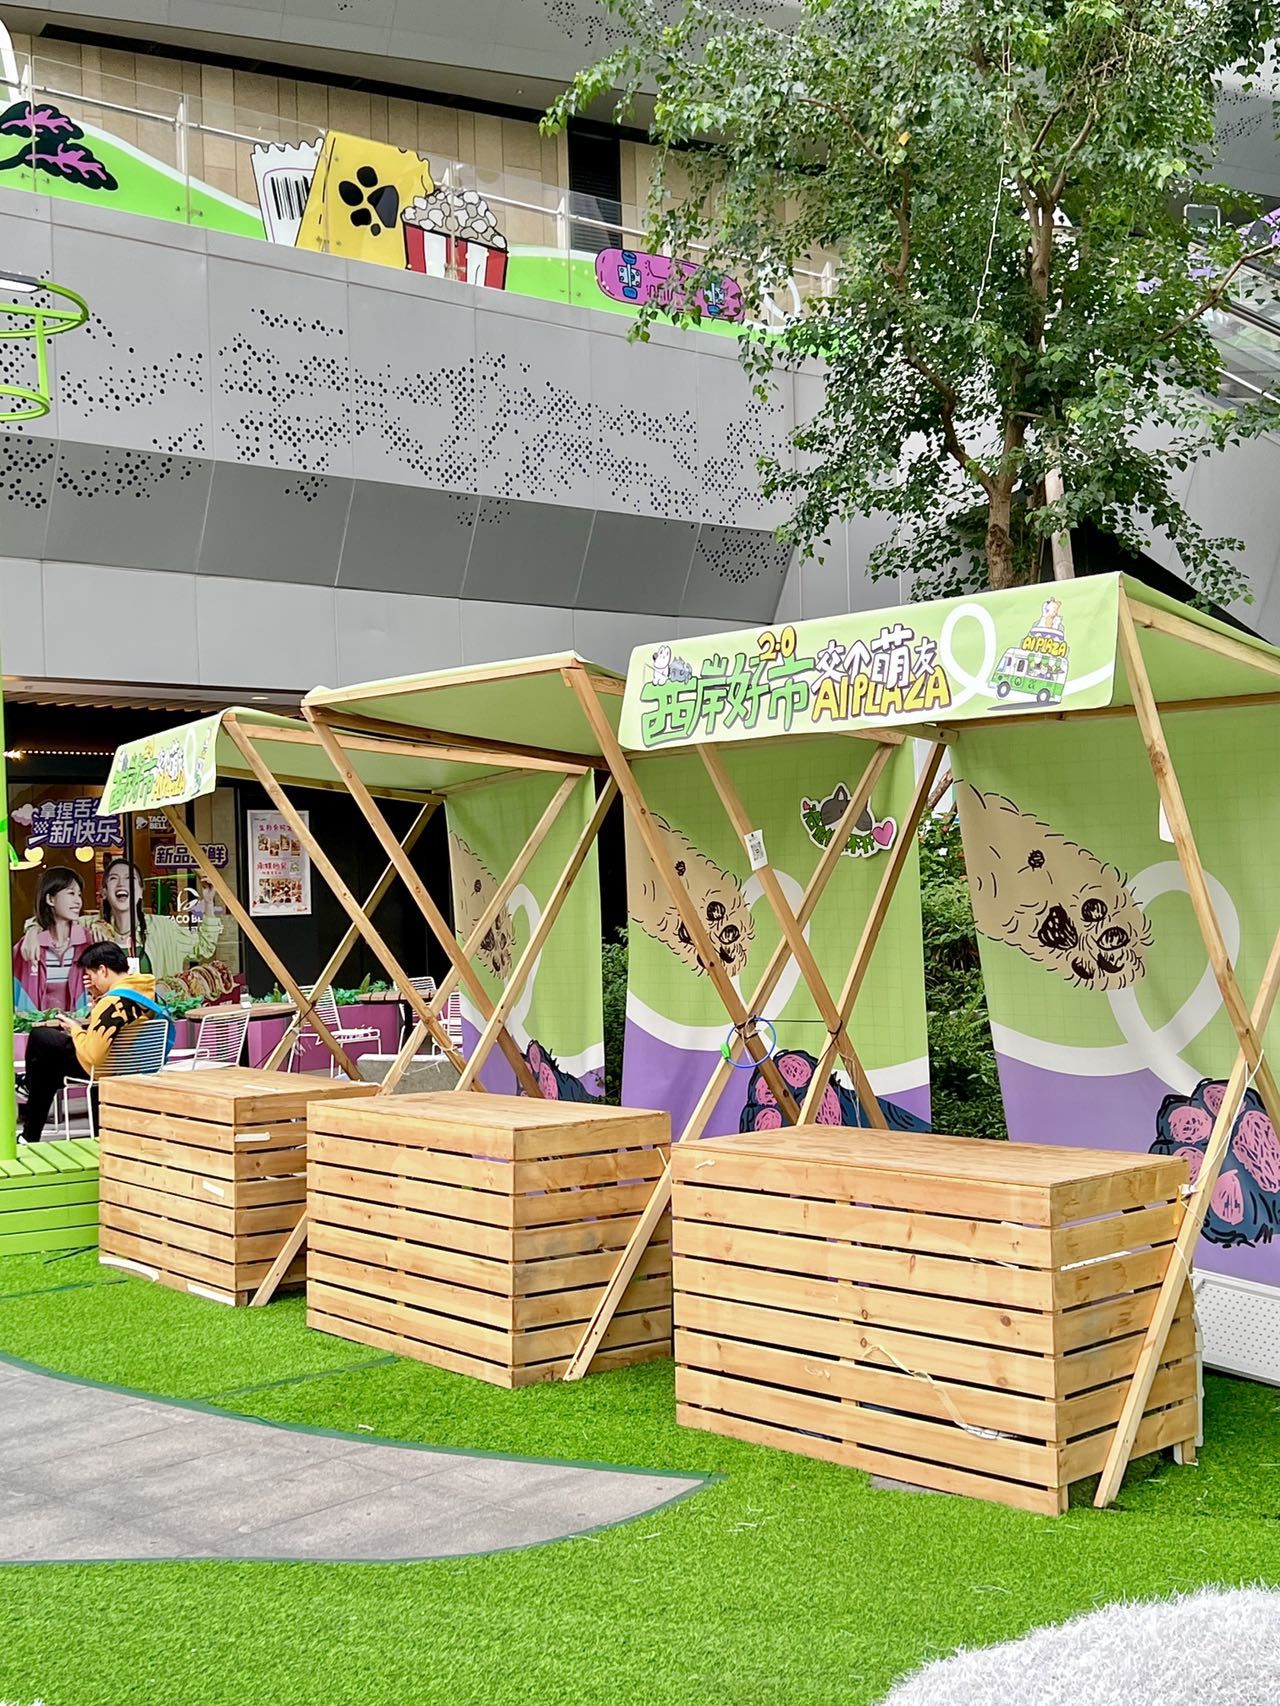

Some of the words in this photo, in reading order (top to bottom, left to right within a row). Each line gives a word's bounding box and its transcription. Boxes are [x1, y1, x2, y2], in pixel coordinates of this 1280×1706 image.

[811, 623, 937, 694] 交个萌友
[640, 652, 817, 748] 西岸好市
[49, 819, 122, 844] 新快乐
[156, 845, 225, 864] 新品鲜
